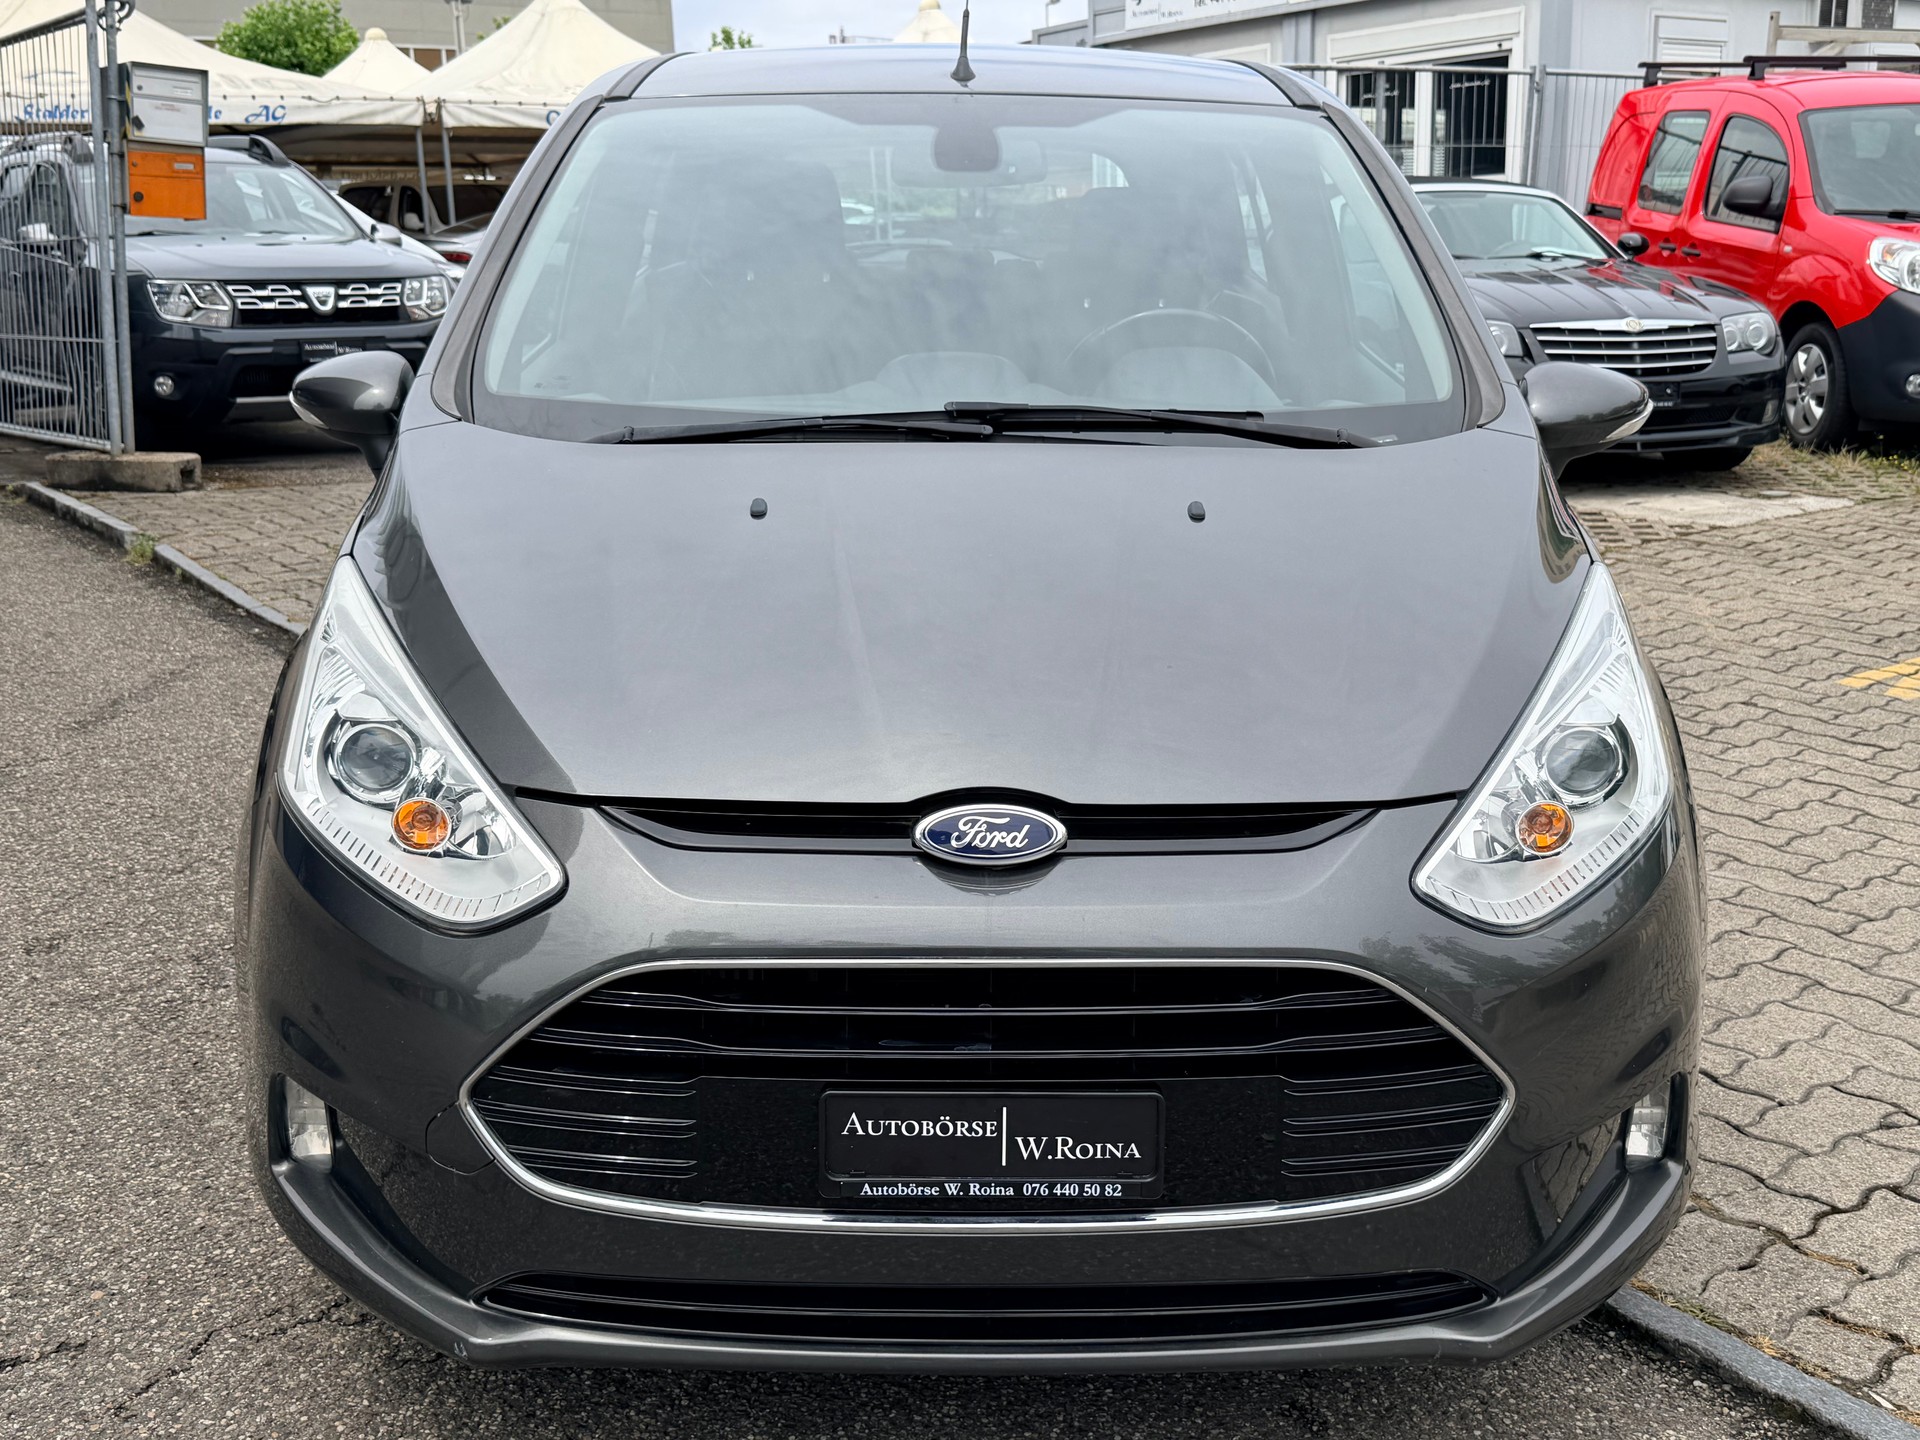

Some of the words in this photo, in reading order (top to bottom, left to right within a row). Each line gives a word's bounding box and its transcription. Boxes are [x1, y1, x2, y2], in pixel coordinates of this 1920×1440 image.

[244, 105, 287, 123] AG
[950, 815, 1031, 848] Ford
[859, 1182, 940, 1197] Autobörse
[943, 1183, 964, 1197] W.
[968, 1182, 1015, 1197] Roina
[1022, 1183, 1049, 1197] 076
[1052, 1183, 1079, 1197] 440
[1082, 1183, 1101, 1197] 50
[1104, 1183, 1123, 1197] 82
